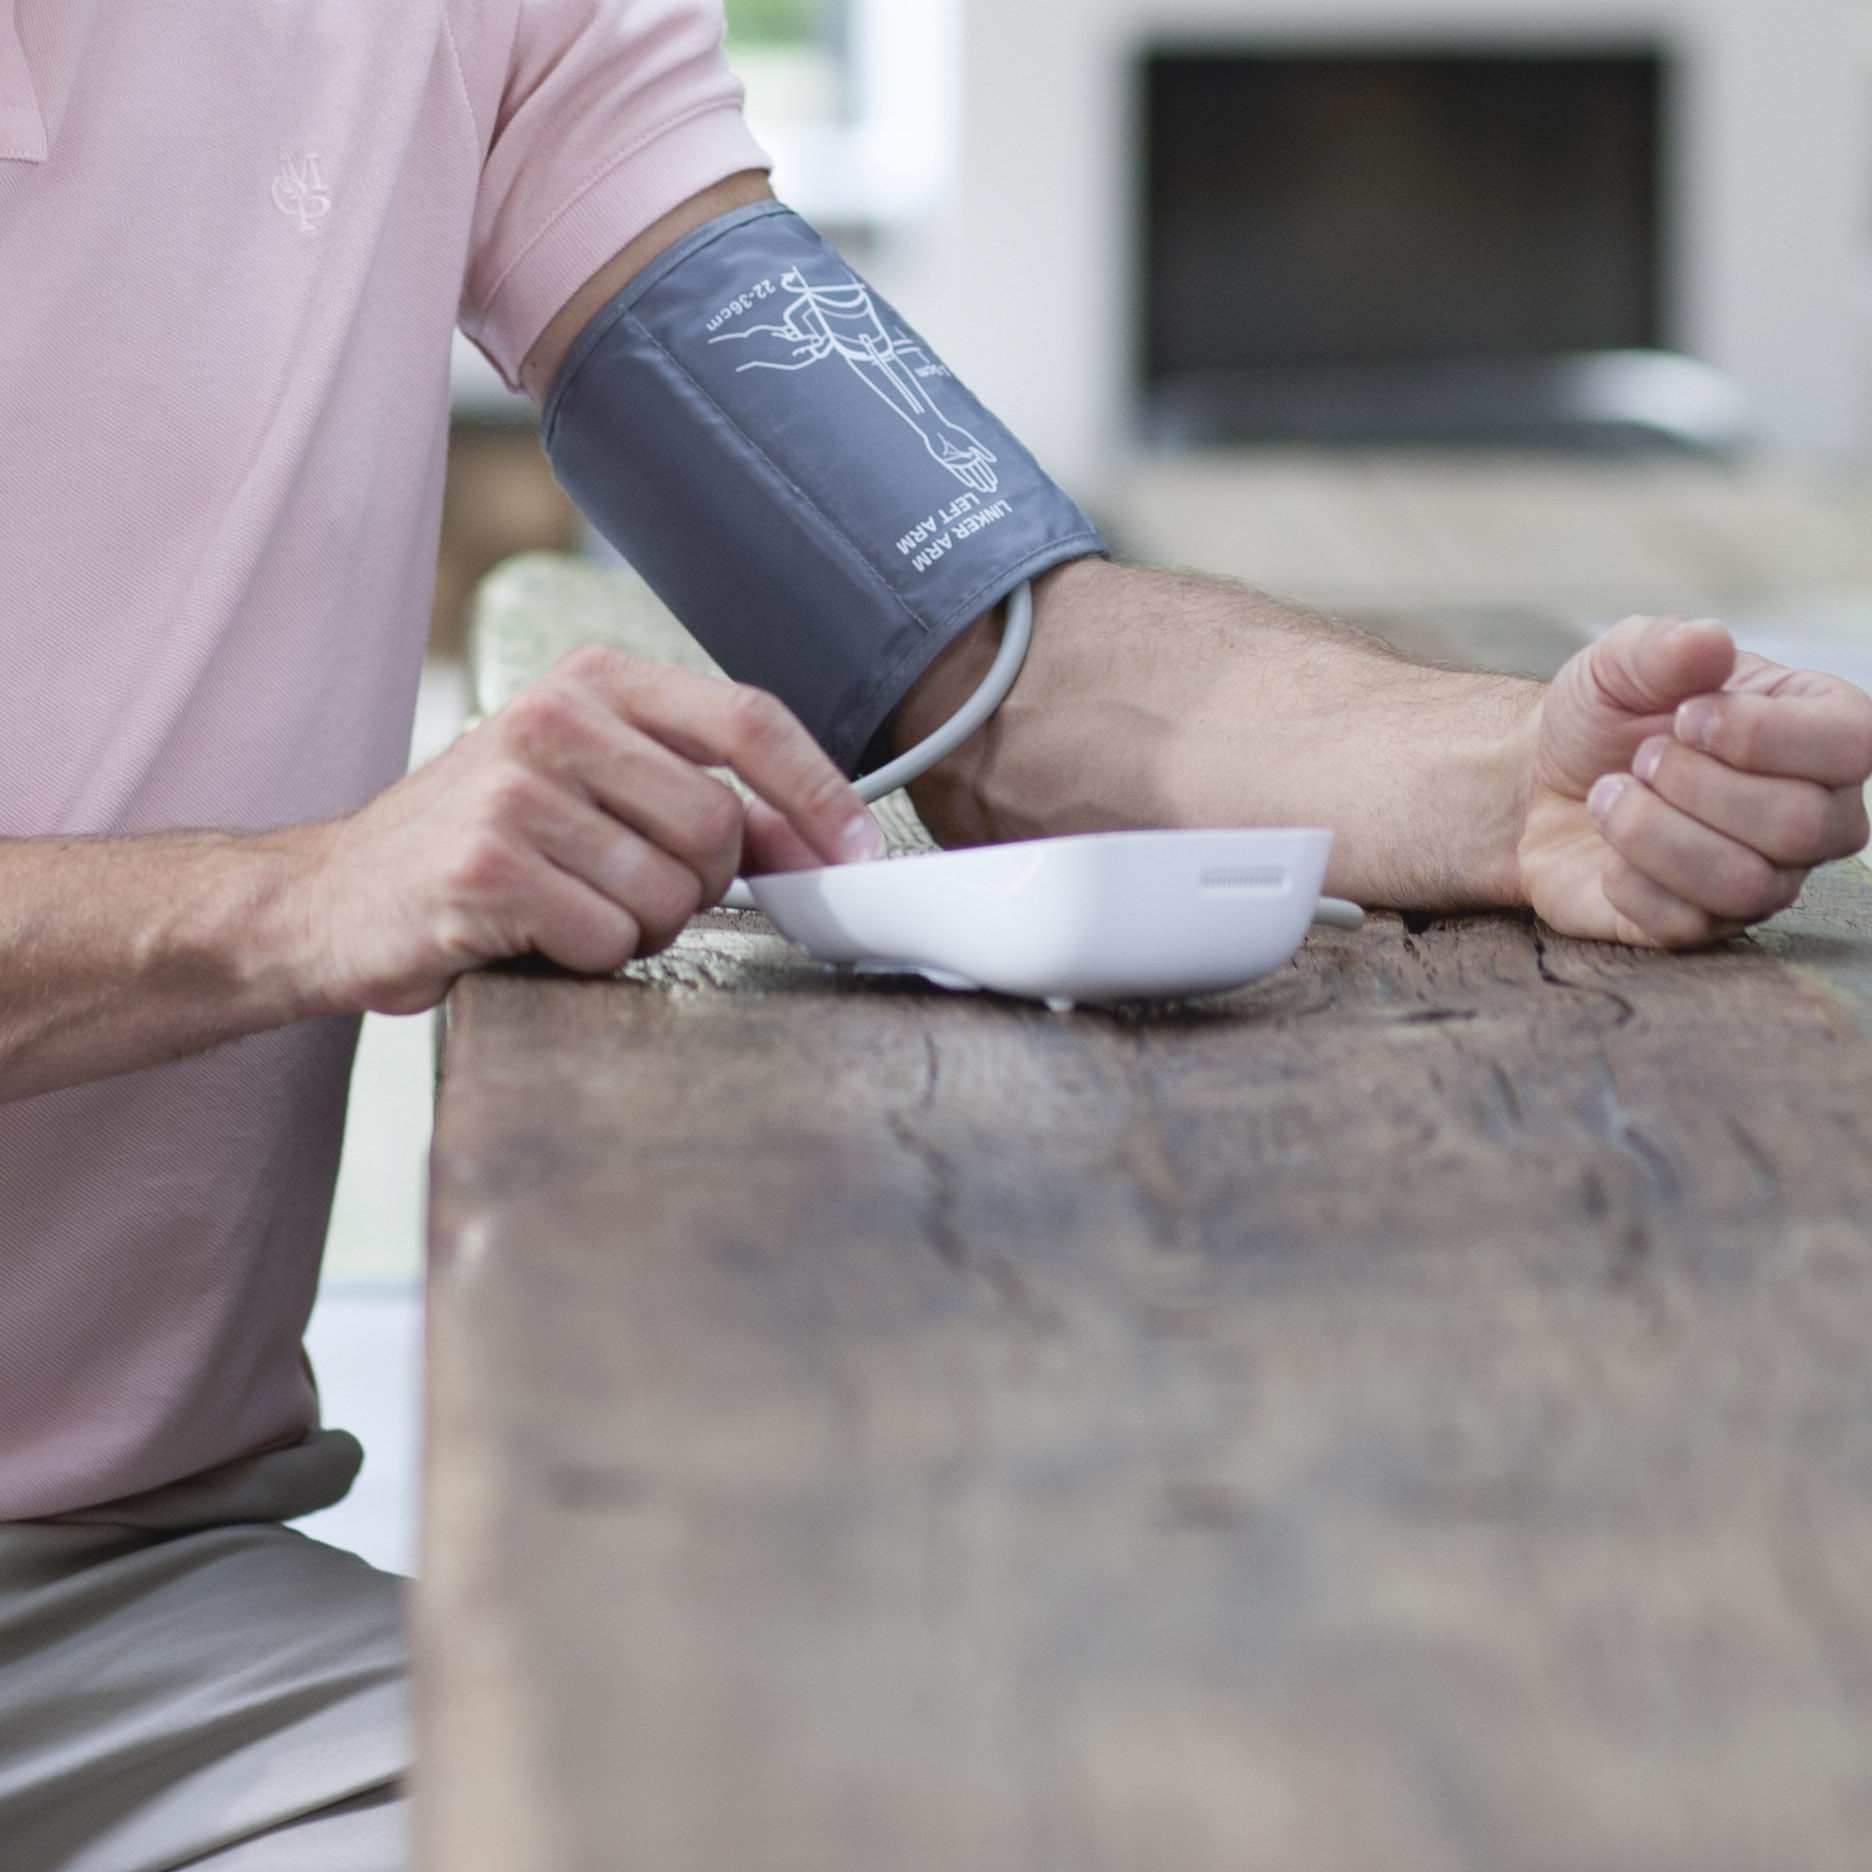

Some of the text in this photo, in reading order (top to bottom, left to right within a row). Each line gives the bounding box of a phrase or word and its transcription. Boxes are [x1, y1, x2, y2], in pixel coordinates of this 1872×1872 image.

[705, 278, 777, 332] 22-36cm
[895, 491, 981, 555] LEFT ARM
[910, 498, 1013, 573] LINKER ARM
